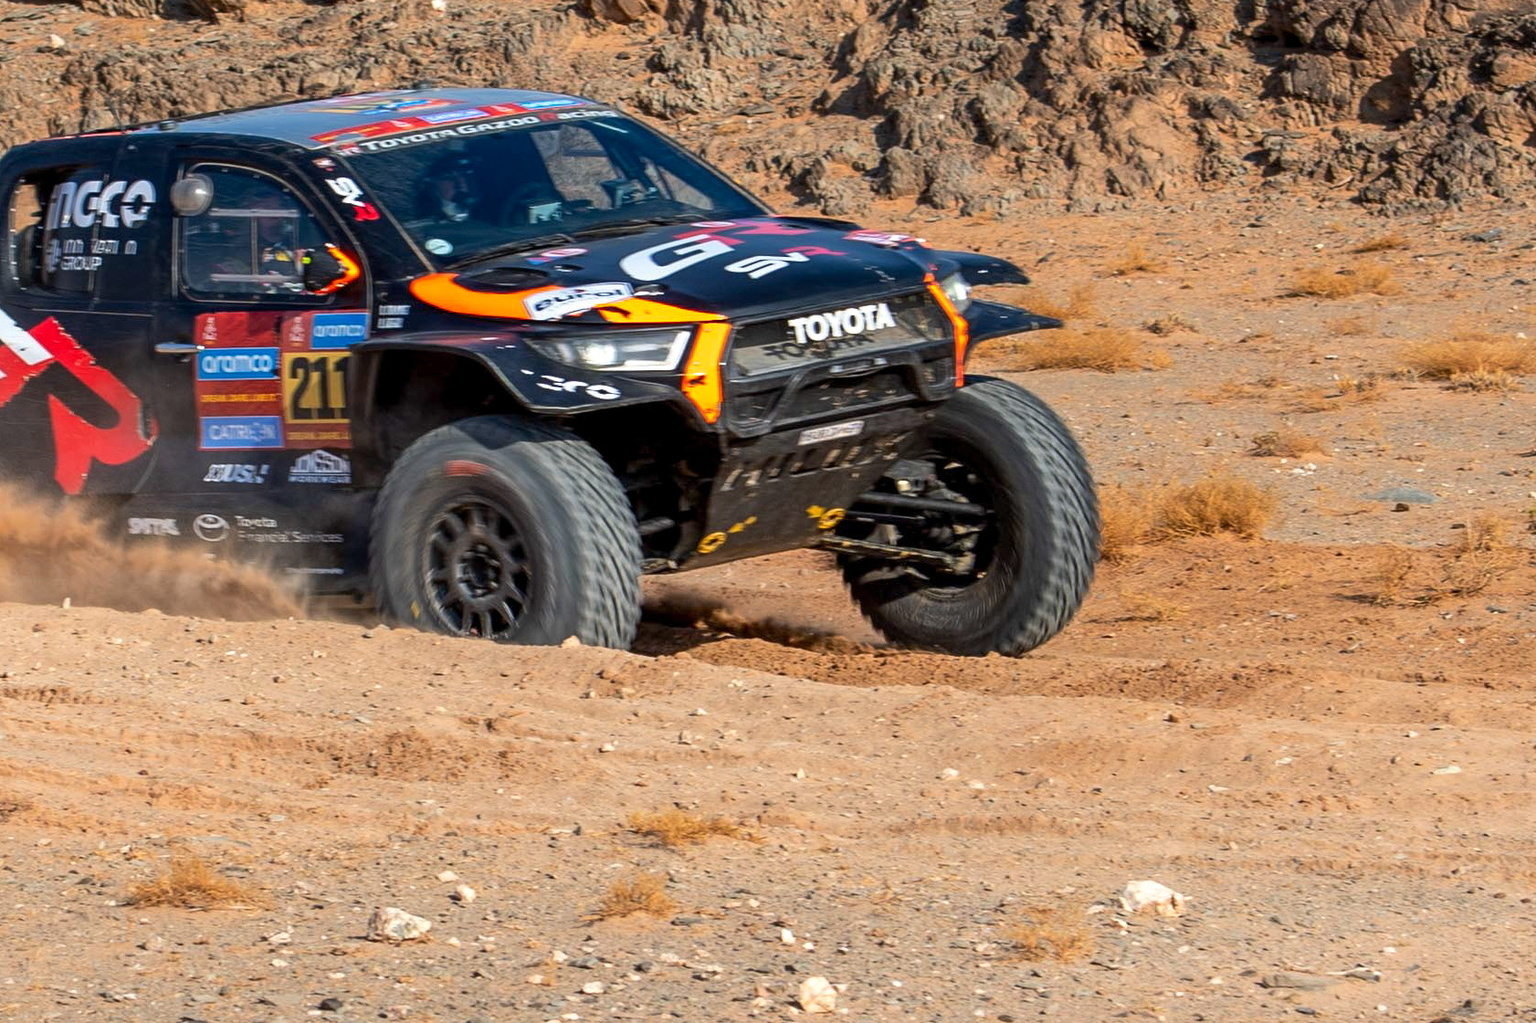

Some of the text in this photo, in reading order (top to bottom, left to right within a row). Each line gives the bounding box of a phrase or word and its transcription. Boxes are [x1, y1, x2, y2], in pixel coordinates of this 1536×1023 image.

[362, 129, 455, 152] TOYOTA
[456, 115, 540, 135] GAZOO
[538, 108, 618, 123] Racing
[787, 303, 897, 344] TOYOTA
[201, 354, 274, 374] aramco
[288, 356, 350, 420] 211
[234, 515, 278, 529] Toyota
[290, 530, 344, 543] Services
